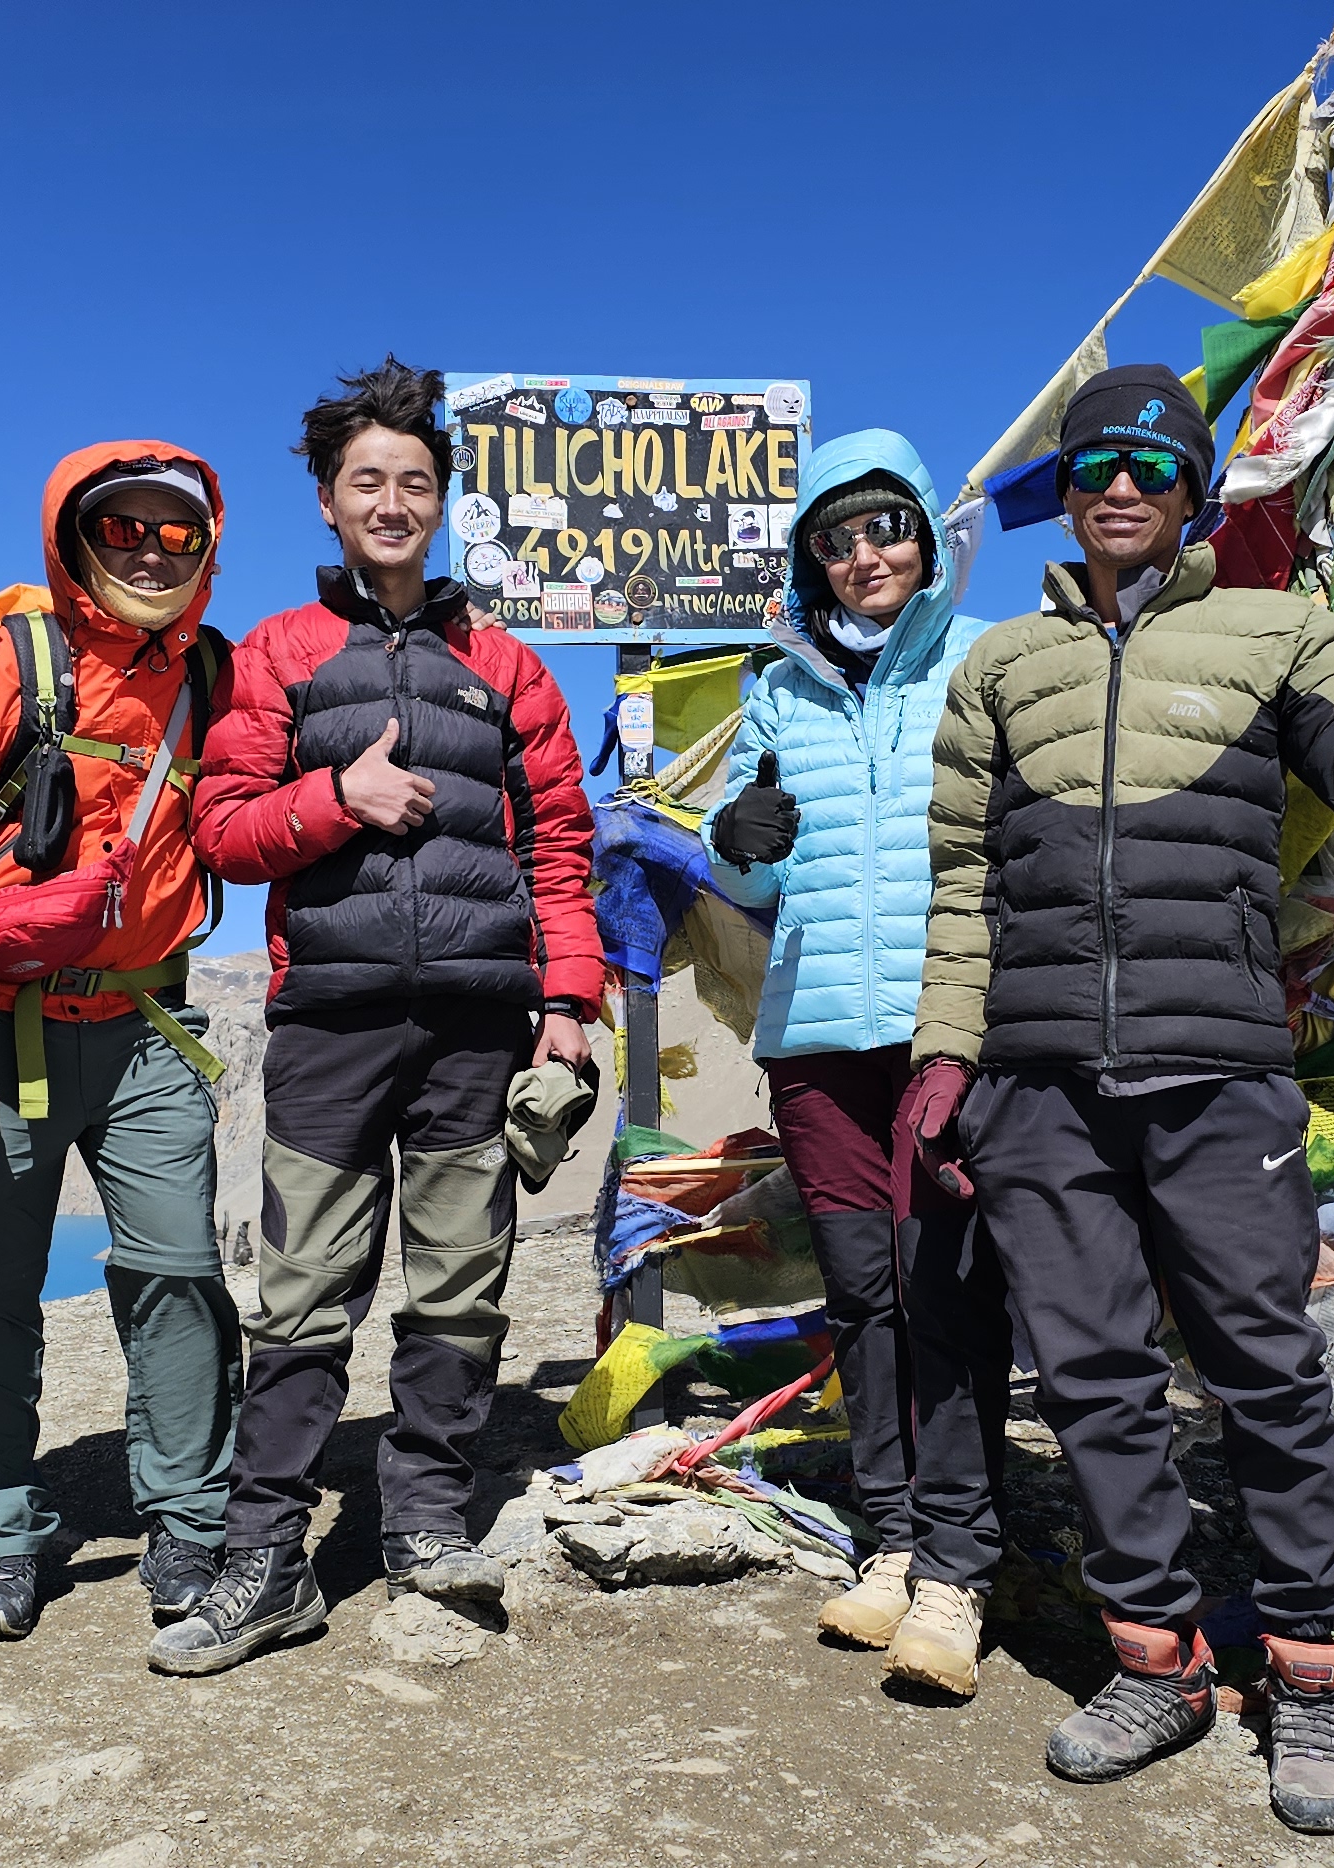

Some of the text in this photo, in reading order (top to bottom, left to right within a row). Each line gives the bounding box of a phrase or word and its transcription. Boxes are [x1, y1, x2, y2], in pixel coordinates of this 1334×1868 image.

[617, 380, 685, 391] ORIGINALS RAW
[467, 424, 798, 499] TILICHO LAKE
[517, 528, 731, 578] 4919 Mtr.
[489, 598, 542, 621] 2080
[1167, 702, 1201, 718] ANTA
